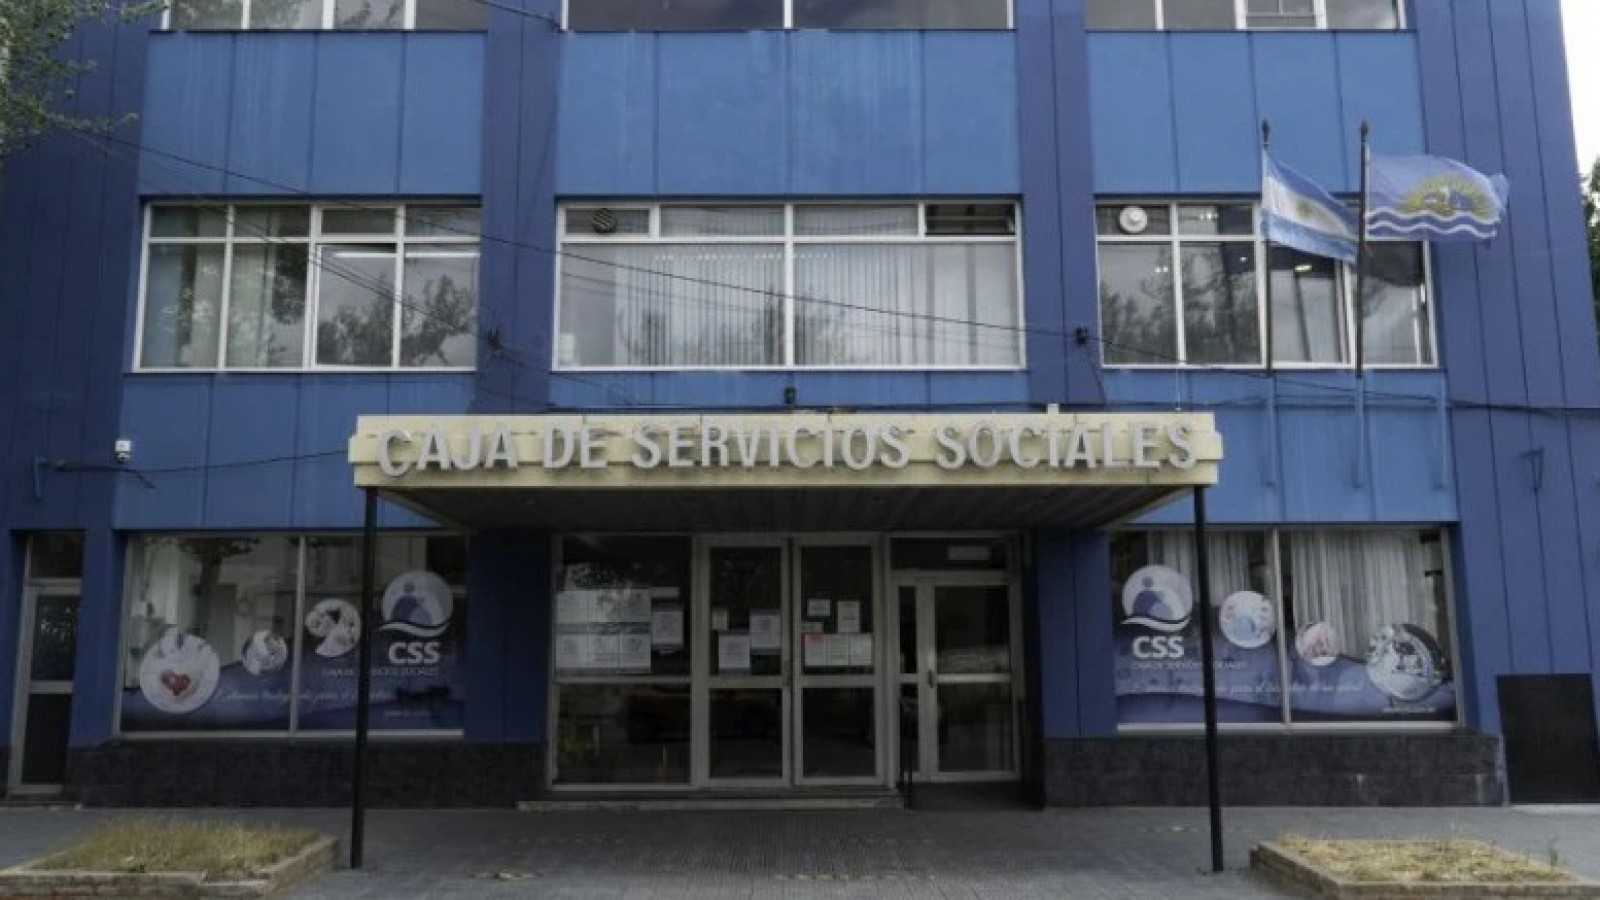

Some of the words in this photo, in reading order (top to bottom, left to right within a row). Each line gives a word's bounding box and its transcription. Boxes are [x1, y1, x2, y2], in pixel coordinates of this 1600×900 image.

[378, 424, 519, 477] CAJA
[542, 425, 608, 469] DE
[632, 422, 911, 470] SERVICIOS
[935, 421, 1200, 470] SOCIALES
[388, 642, 441, 664] CSS
[1132, 635, 1184, 659] CSS
